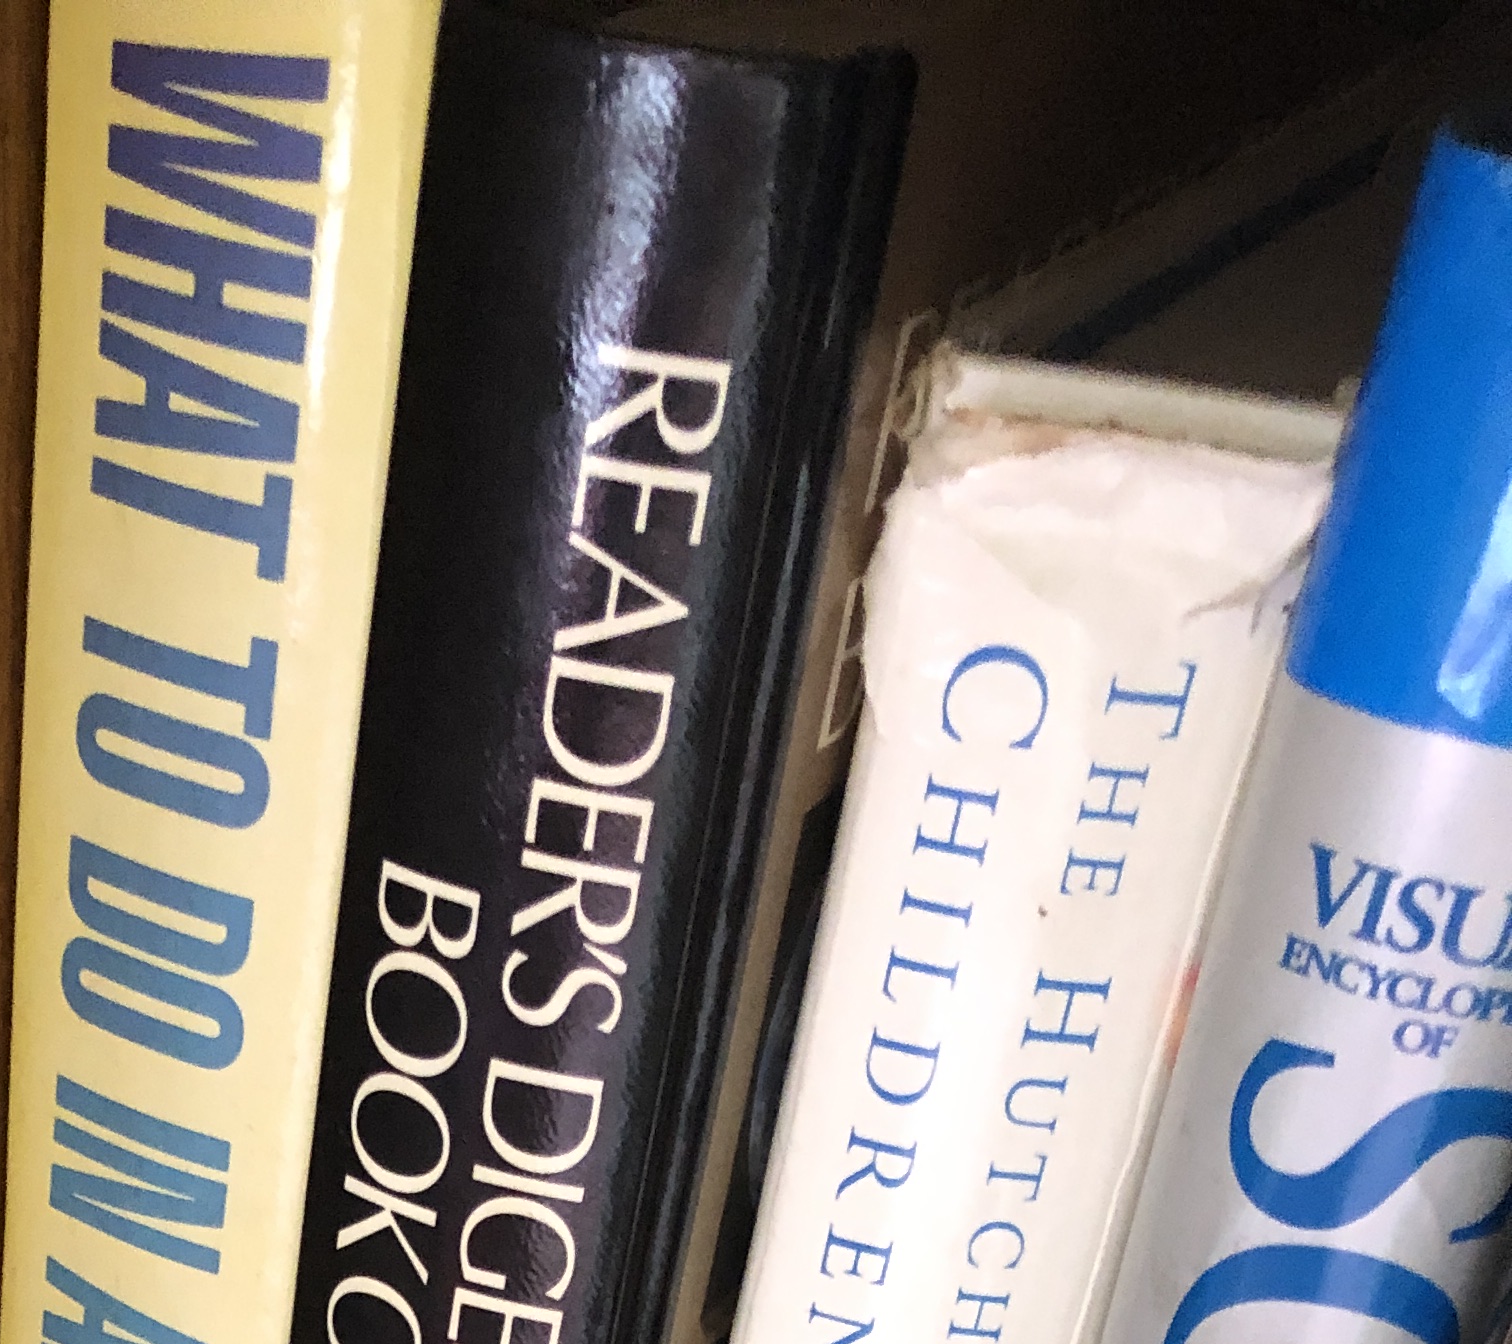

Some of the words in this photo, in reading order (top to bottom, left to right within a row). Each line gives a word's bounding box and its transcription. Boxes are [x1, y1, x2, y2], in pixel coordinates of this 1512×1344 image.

[89, 39, 331, 584] WHAT
[75, 615, 279, 830] TO
[501, 345, 734, 1035] READER'S
[1059, 662, 1197, 897] THE
[60, 834, 255, 1071] DO
[1308, 838, 1512, 968] VISU
[337, 859, 482, 1285] BOOK
[1392, 1019, 1460, 1058] OF
[46, 1074, 231, 1274] IN
